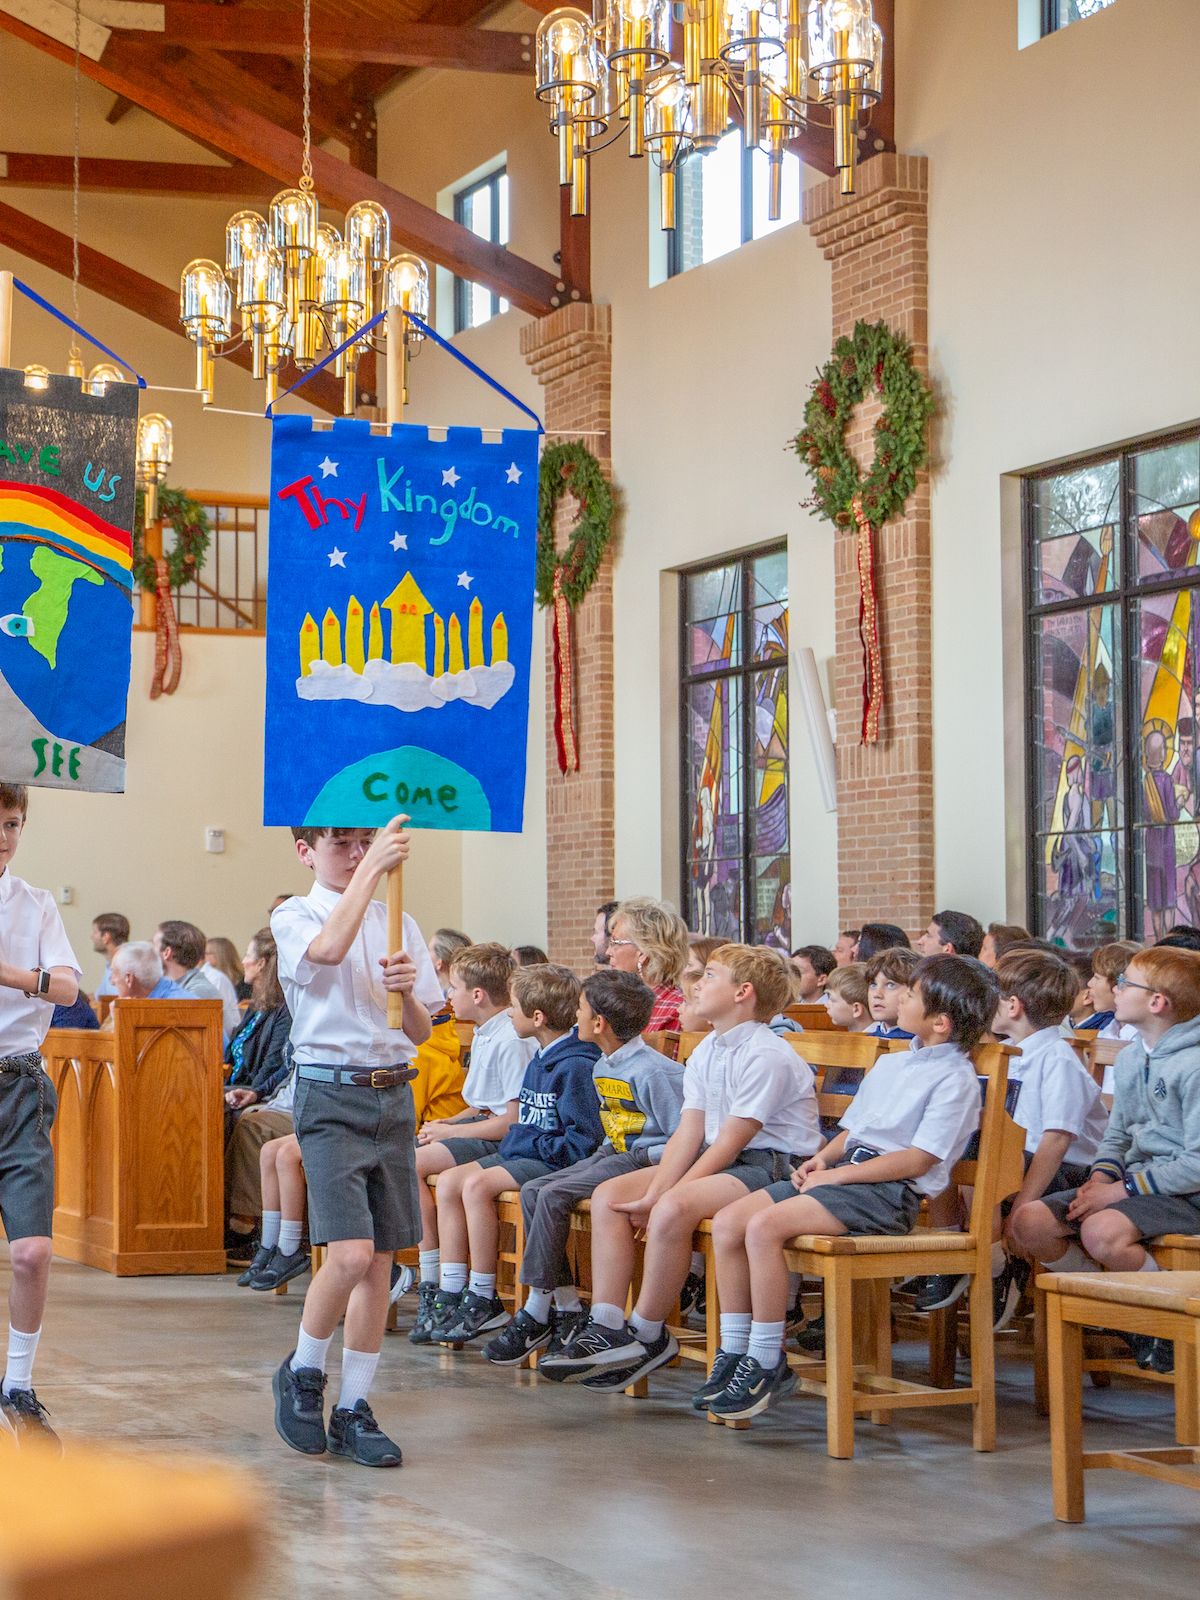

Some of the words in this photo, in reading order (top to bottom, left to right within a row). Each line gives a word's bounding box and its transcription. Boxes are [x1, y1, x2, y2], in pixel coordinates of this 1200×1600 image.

[83, 462, 122, 502] US
[277, 475, 367, 532] Thy
[377, 457, 519, 546] Kingdom
[31, 738, 81, 780] SEE
[362, 772, 459, 813] Come
